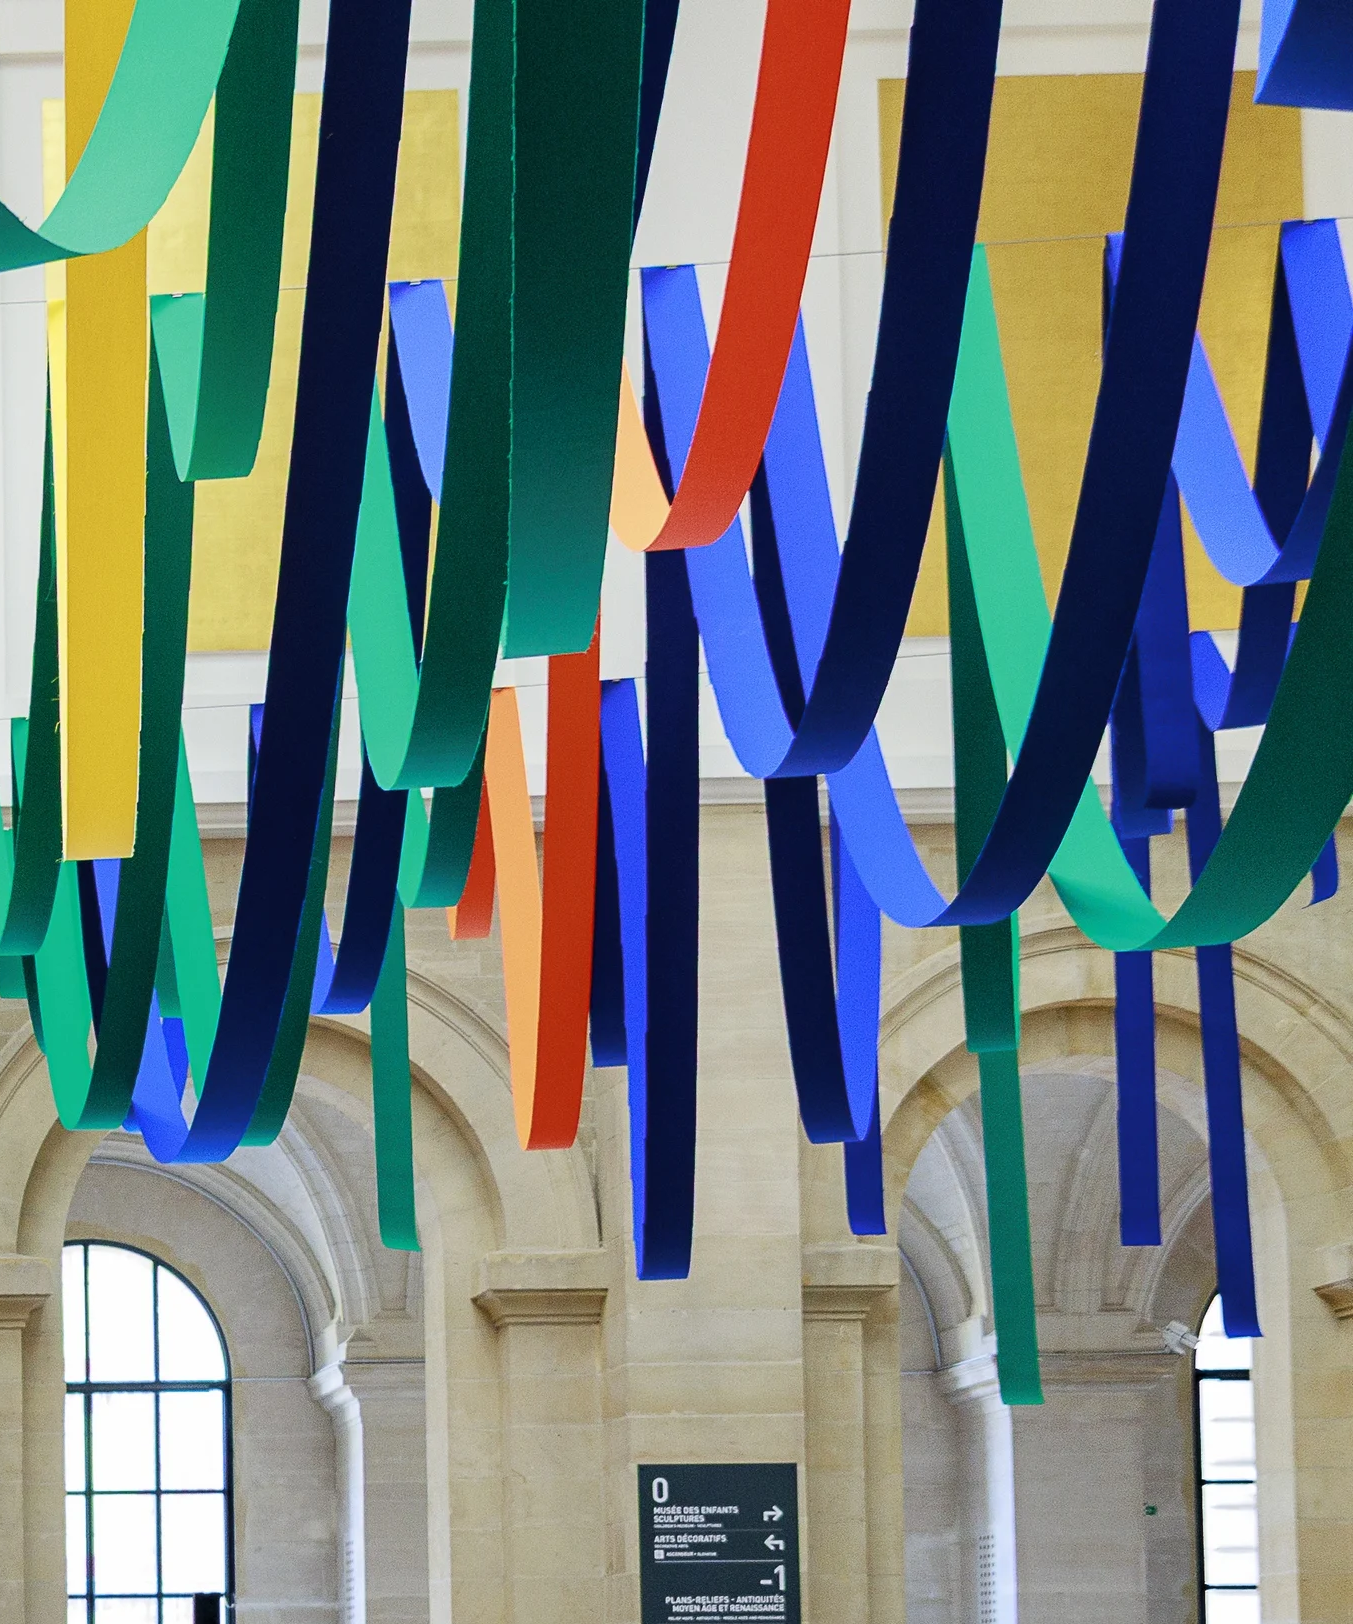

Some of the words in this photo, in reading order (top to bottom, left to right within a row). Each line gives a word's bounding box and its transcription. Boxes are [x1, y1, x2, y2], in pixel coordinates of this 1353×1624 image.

[652, 1477, 668, 1503] 0
[654, 1505, 682, 1515] MUSÉE
[683, 1506, 700, 1515] DES
[701, 1506, 739, 1514] ENFANTS
[654, 1515, 705, 1523] SCULPTURES
[654, 1535, 676, 1543] ARTS
[677, 1533, 727, 1543] DÉCORATIFS
[760, 1565, 786, 1591] -1
[665, 1596, 729, 1604] PLANS-RELIEFS
[736, 1594, 785, 1603] ANTIQUITÉS
[673, 1604, 700, 1612] MOYEN
[719, 1604, 728, 1612] ET
[730, 1604, 785, 1612] RENAISSANCE
